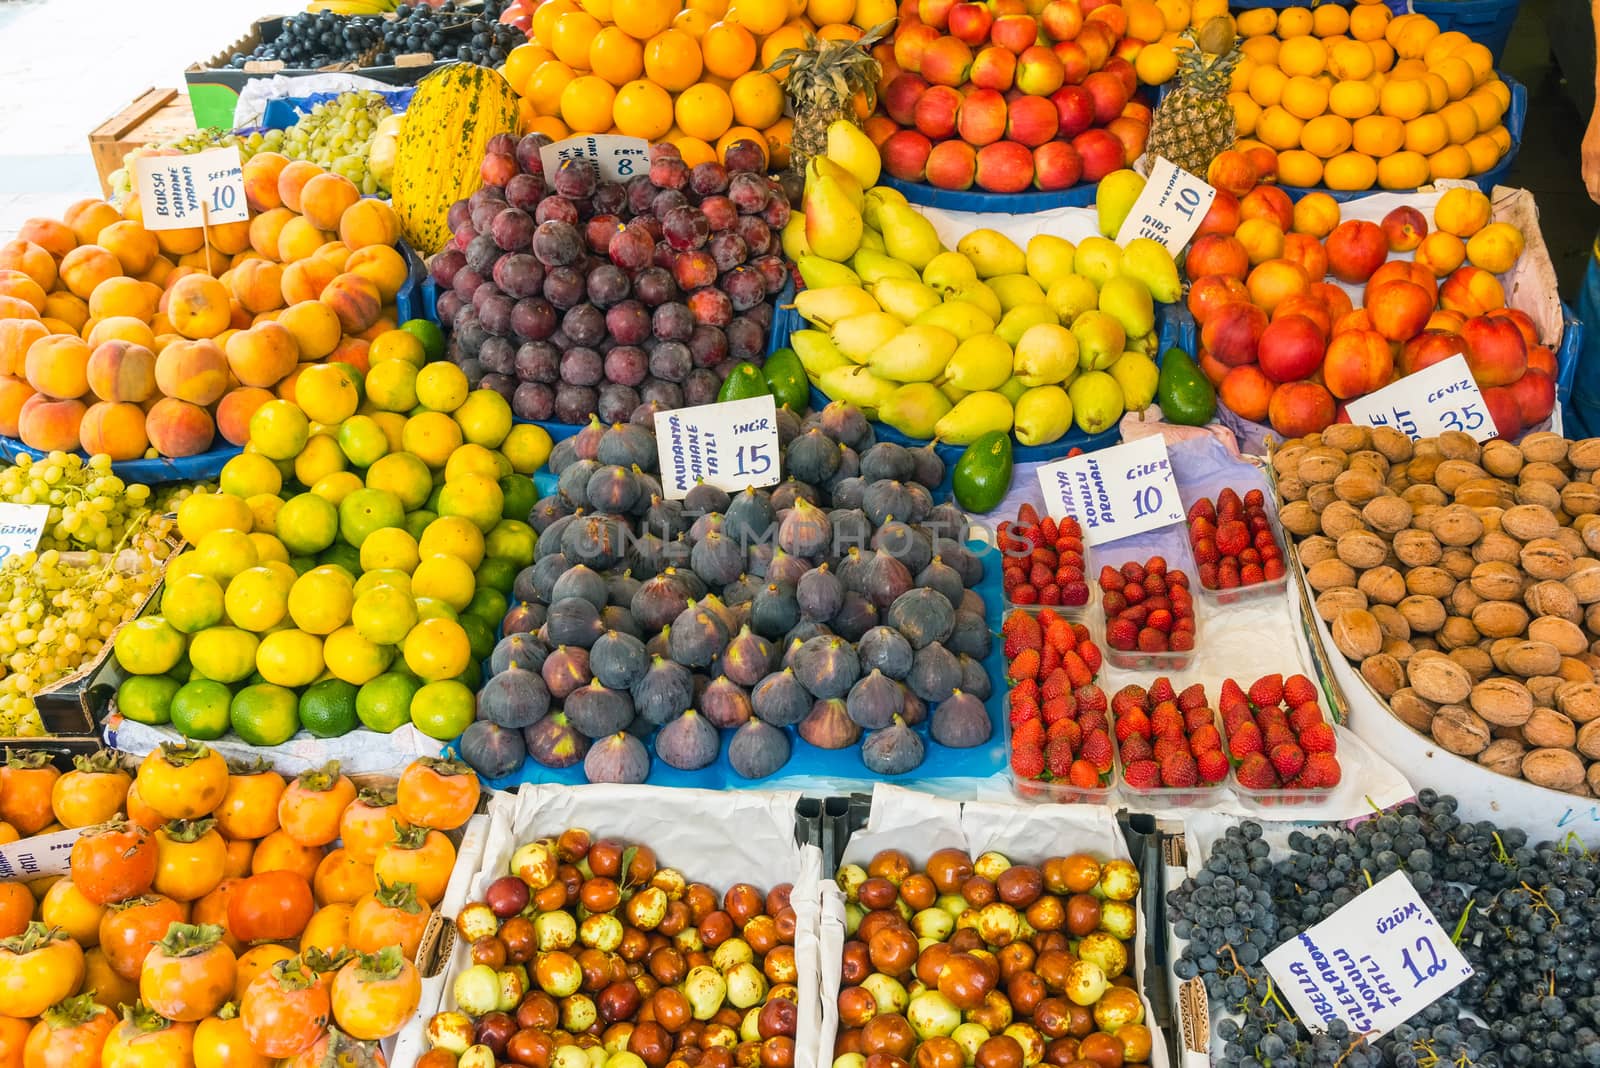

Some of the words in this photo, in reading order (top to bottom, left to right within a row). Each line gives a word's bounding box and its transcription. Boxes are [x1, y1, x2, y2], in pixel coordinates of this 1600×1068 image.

[182, 166, 200, 211] YARMA
[617, 159, 633, 175] 8
[152, 173, 169, 216] BURSA
[210, 185, 235, 213] 10
[1174, 188, 1201, 222] 10
[1142, 214, 1171, 234] SULU
[1440, 403, 1484, 432] 35
[669, 415, 687, 490] MUDANYA
[686, 424, 704, 482] SAHANE
[704, 432, 718, 476] TATLI
[733, 443, 771, 476] 15
[1075, 472, 1099, 528] KOKULU
[1087, 459, 1115, 523] AROMALI
[1132, 486, 1163, 519] 10
[17, 853, 41, 874] TATLI
[1333, 948, 1385, 1013] KOKULU
[1360, 955, 1402, 1007] TATLI
[1401, 936, 1447, 988] 12
